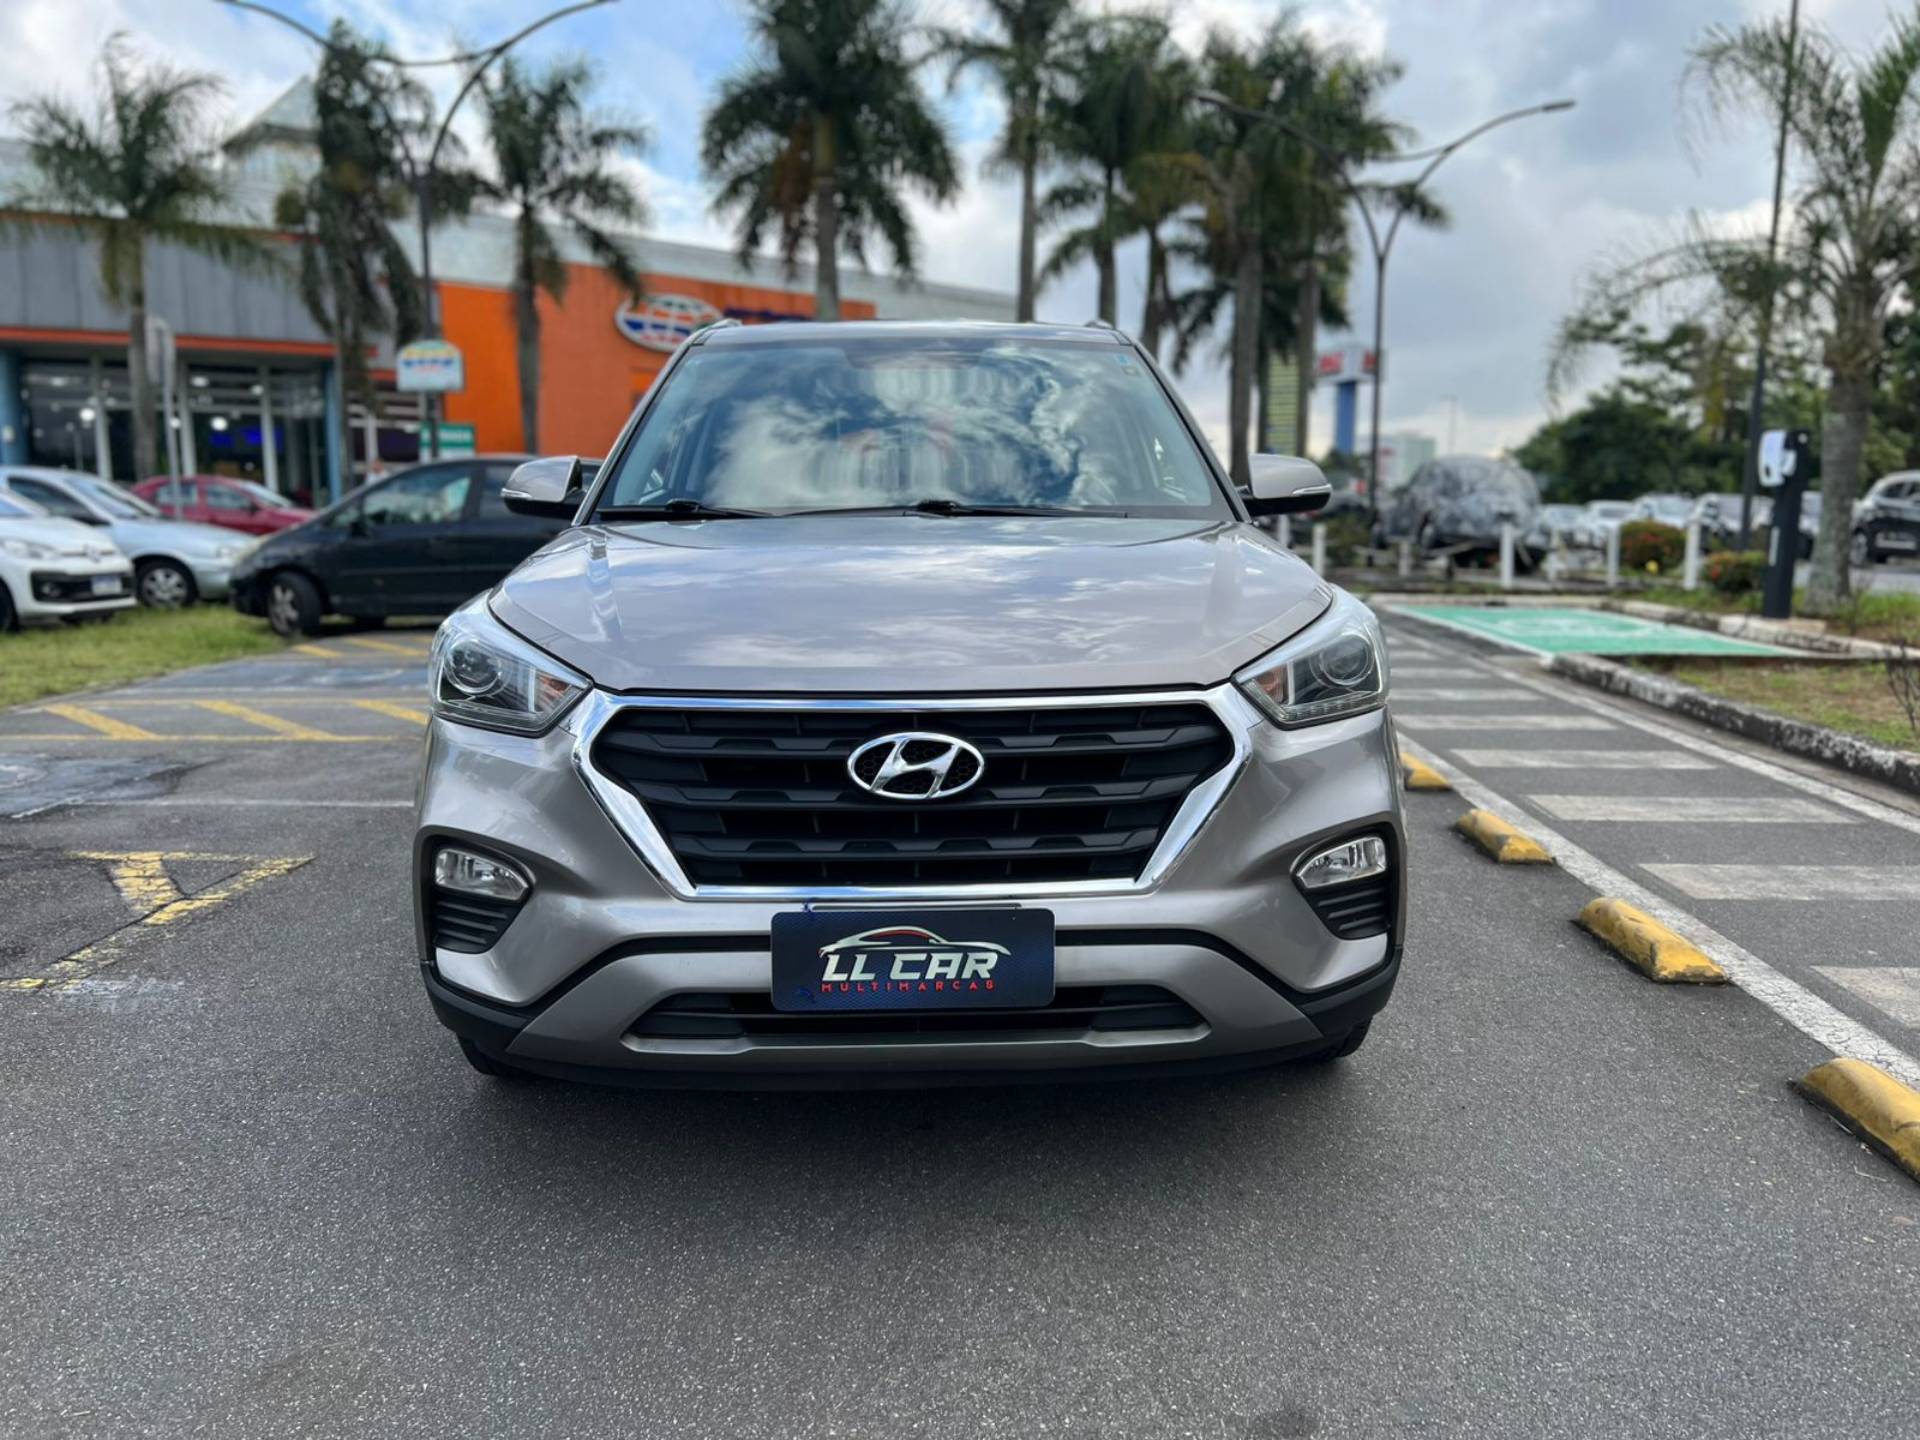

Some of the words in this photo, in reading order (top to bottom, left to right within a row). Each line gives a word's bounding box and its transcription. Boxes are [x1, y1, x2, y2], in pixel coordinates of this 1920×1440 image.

[822, 954, 876, 981] LL
[889, 952, 998, 980] CAR
[821, 980, 994, 993] MULTIMARCAS
